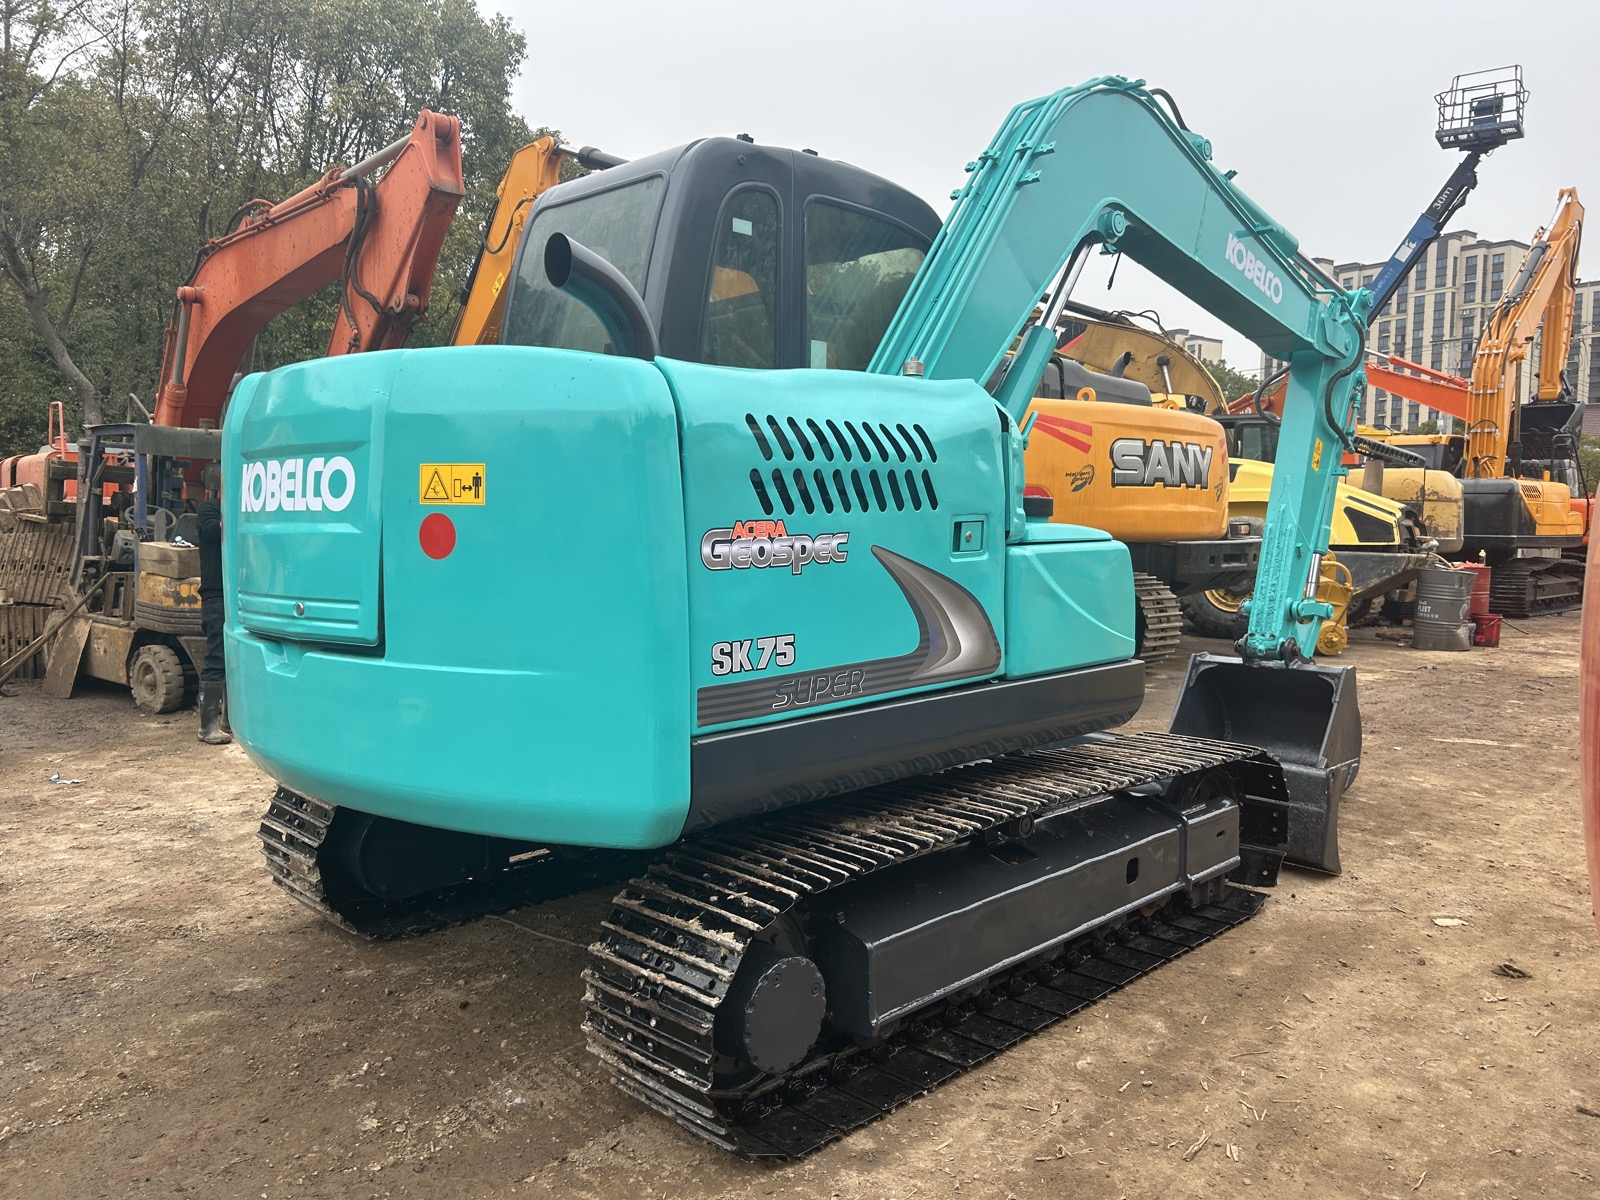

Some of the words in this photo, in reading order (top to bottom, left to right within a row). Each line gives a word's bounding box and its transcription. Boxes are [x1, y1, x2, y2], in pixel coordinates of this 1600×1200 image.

[1433, 187, 1453, 210] 30m
[1225, 232, 1283, 304] KOBELCO
[241, 456, 355, 512] KOBELCO
[1110, 438, 1213, 489] SANY
[732, 519, 788, 539] ACERA
[772, 669, 866, 710] SUPER
